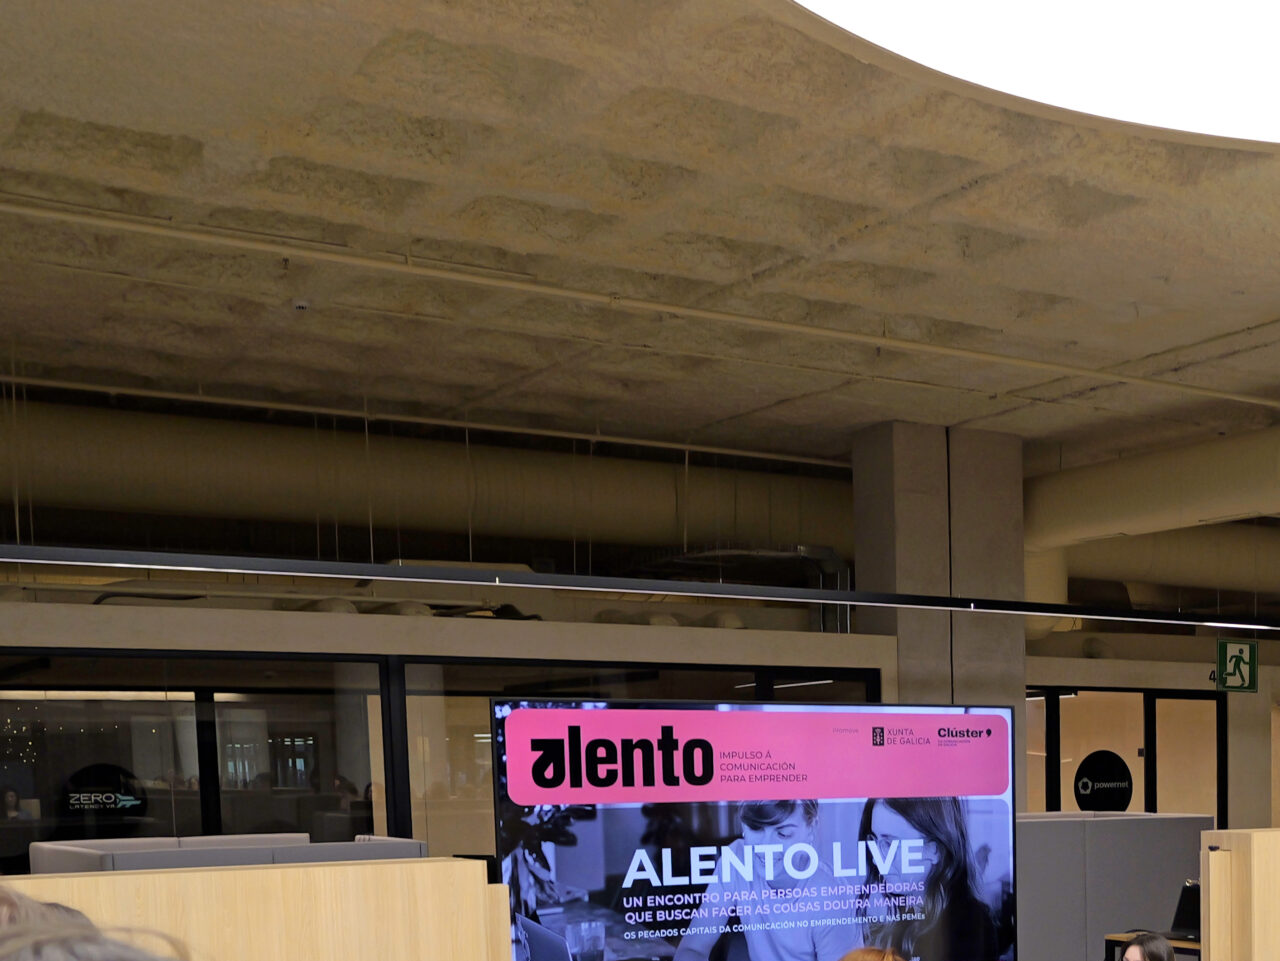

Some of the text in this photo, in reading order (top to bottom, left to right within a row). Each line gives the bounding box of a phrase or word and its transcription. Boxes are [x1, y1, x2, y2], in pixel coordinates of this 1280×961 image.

[1209, 670, 1217, 682] 4
[886, 728, 914, 736] XUNTA
[937, 727, 983, 738] Clúster
[900, 737, 931, 745] GALICIA
[530, 725, 714, 788] alento
[719, 750, 762, 760] IMPULSO
[719, 761, 795, 771] COMUNICACIÓN
[720, 773, 808, 783] PARA EMPRENDER
[1094, 781, 1129, 790] powernet
[69, 793, 115, 804] ZERO
[622, 839, 925, 888] ALENTO LIVE
[623, 881, 925, 908] UN ENCONTRO PARA PERSOAS EMPRENDEDORAS
[625, 895, 924, 925] QUE BUSCAN FACER AS COUSAS DOUTRA MANEIRA
[624, 931, 636, 940] OS
[638, 928, 679, 938] PECADOS
[679, 926, 717, 936] CAPITAIS
[719, 925, 731, 933] DA
[732, 920, 795, 932] COMUNICACIÓN
[797, 920, 809, 928] NO
[810, 916, 877, 927] EMPRENDEMENTO
[885, 914, 901, 922] NAS
